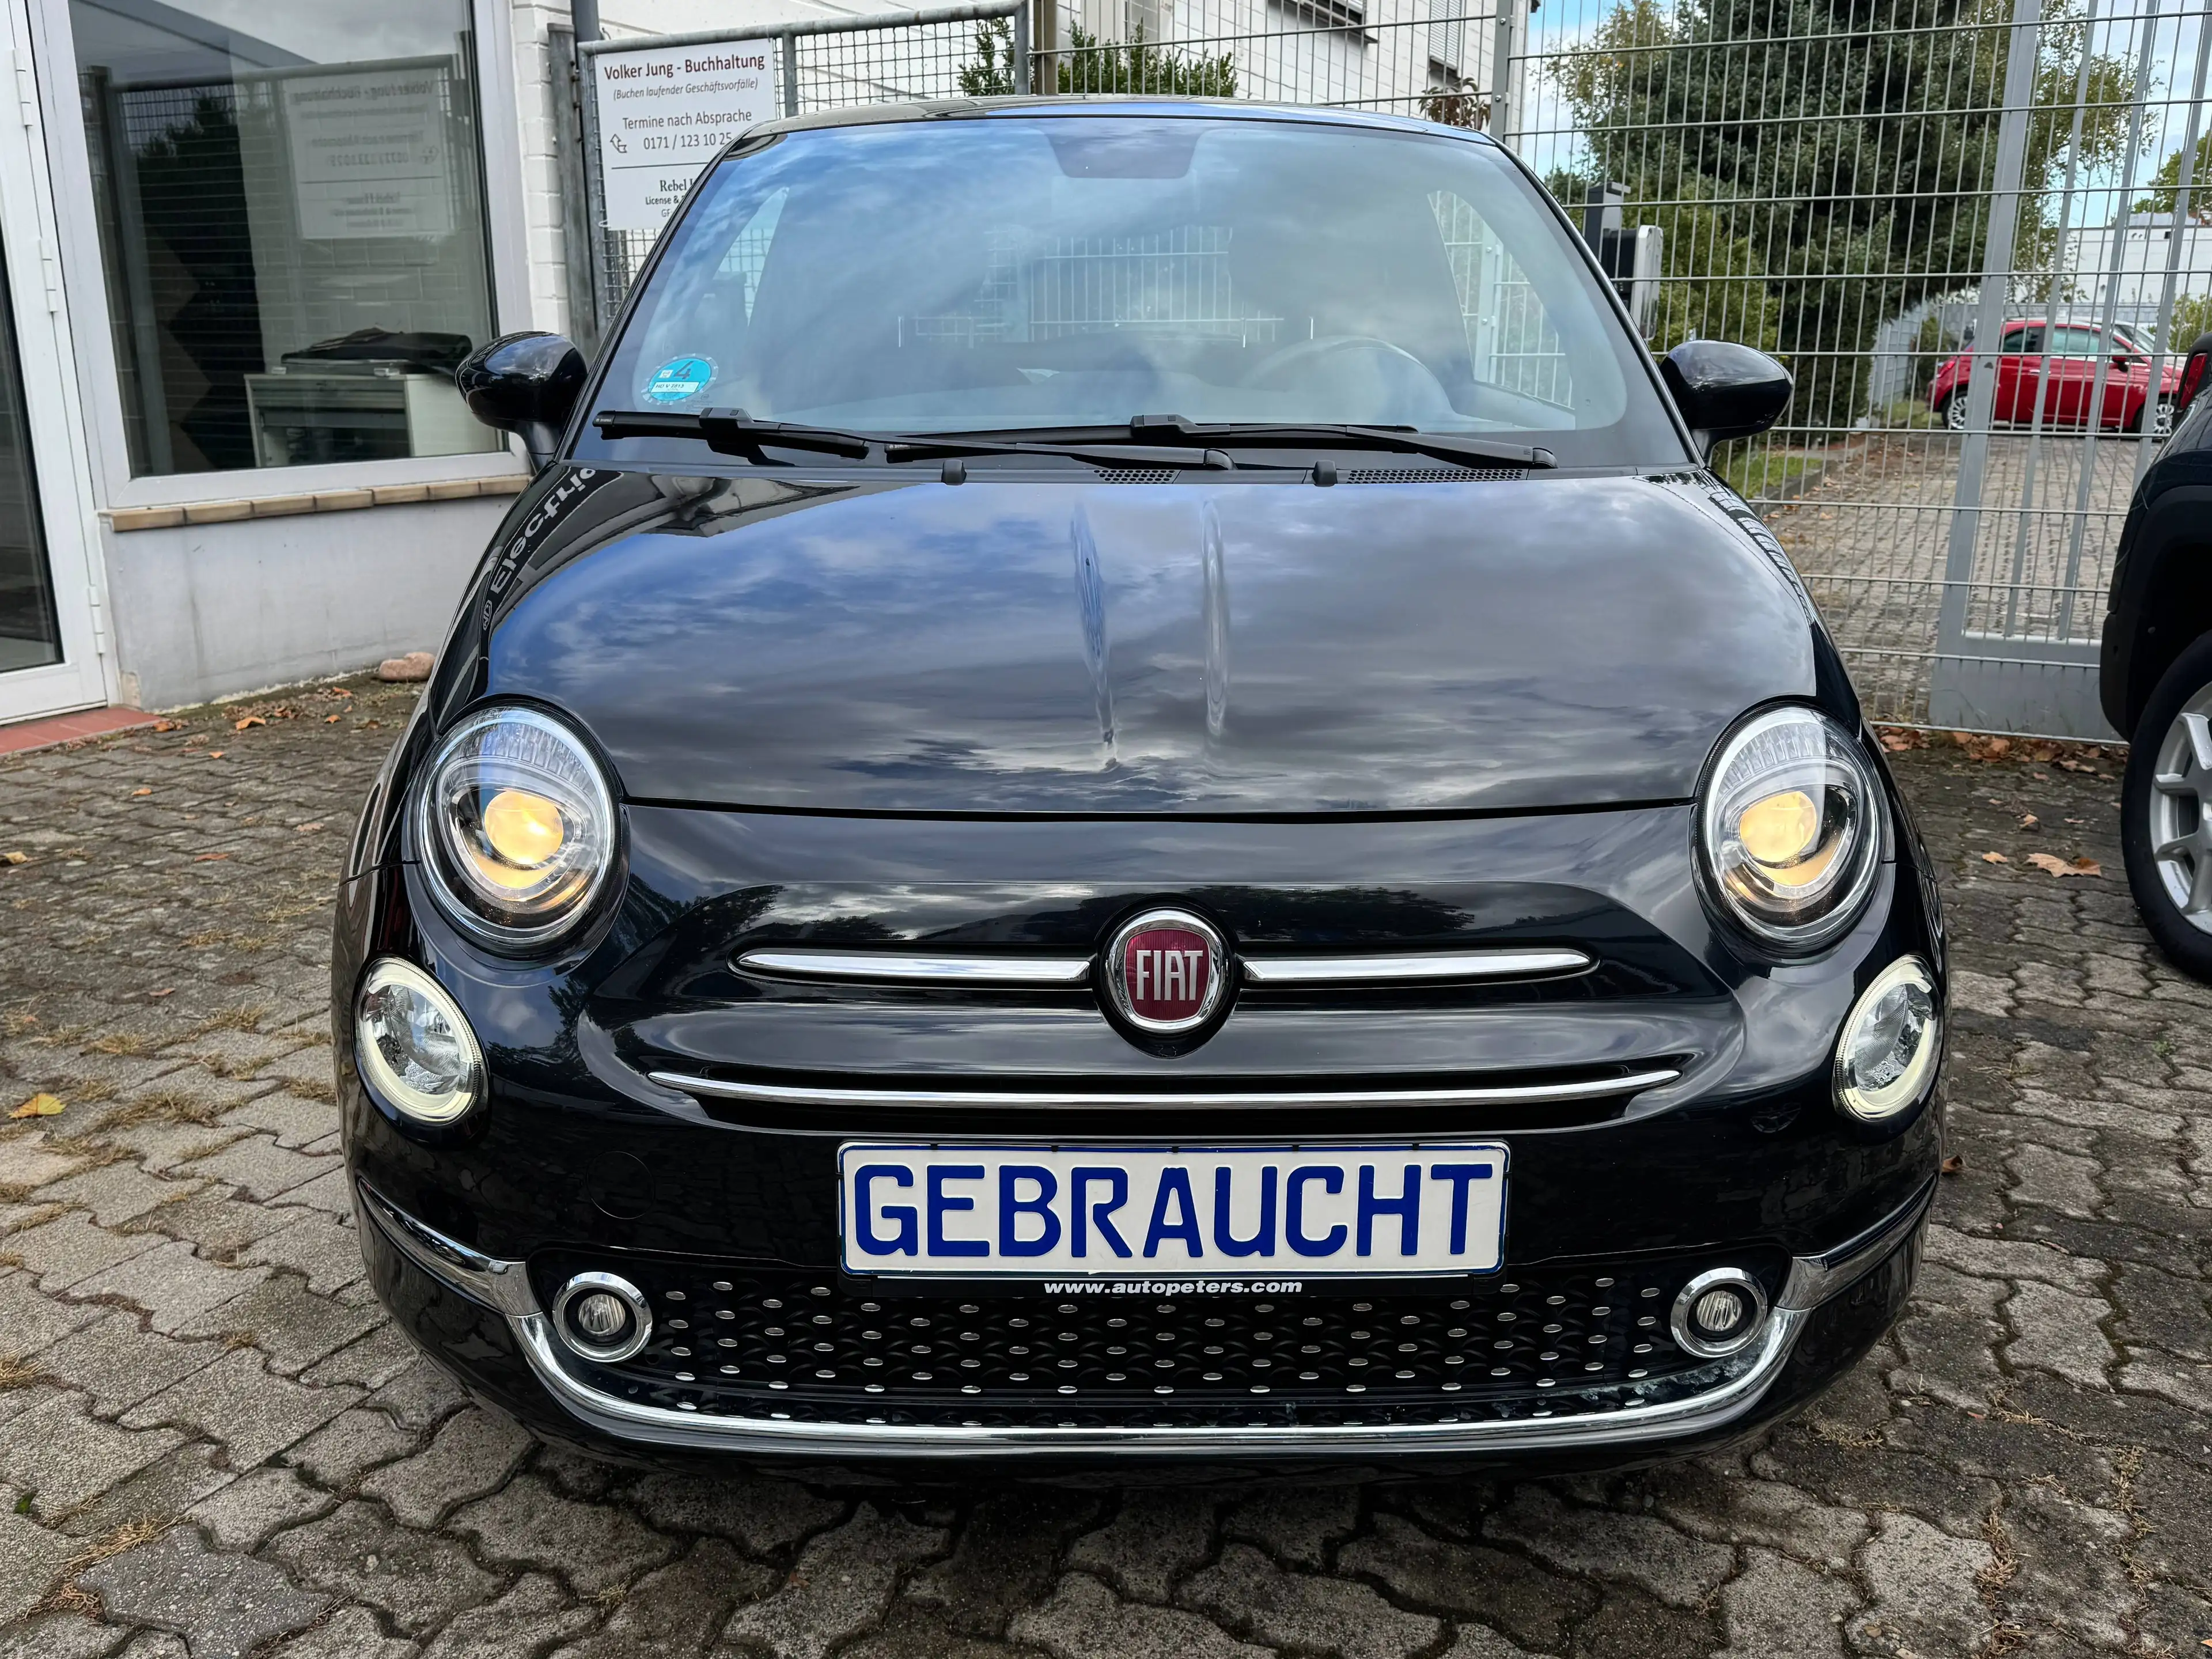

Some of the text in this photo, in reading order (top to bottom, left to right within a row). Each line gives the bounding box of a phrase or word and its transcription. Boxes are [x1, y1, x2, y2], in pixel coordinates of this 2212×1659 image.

[604, 64, 642, 79] Volker
[645, 62, 673, 78] Jung
[685, 55, 765, 73] Buchhaltung
[613, 78, 759, 101] (Buchen laufender Geschäftsvorfälle)
[623, 109, 752, 130] Termine nach Absprache
[643, 136, 669, 150] 0171
[681, 134, 699, 147] 123
[703, 132, 716, 146] 10
[719, 132, 732, 145] 25
[660, 179, 687, 192] Rebel
[645, 196, 672, 205] License
[673, 361, 694, 380] 4
[1136, 949, 1203, 1001] FIAT
[853, 1164, 1494, 1259] GEBRAUCHT
[1044, 1280, 1302, 1296] www.autopeters.com
